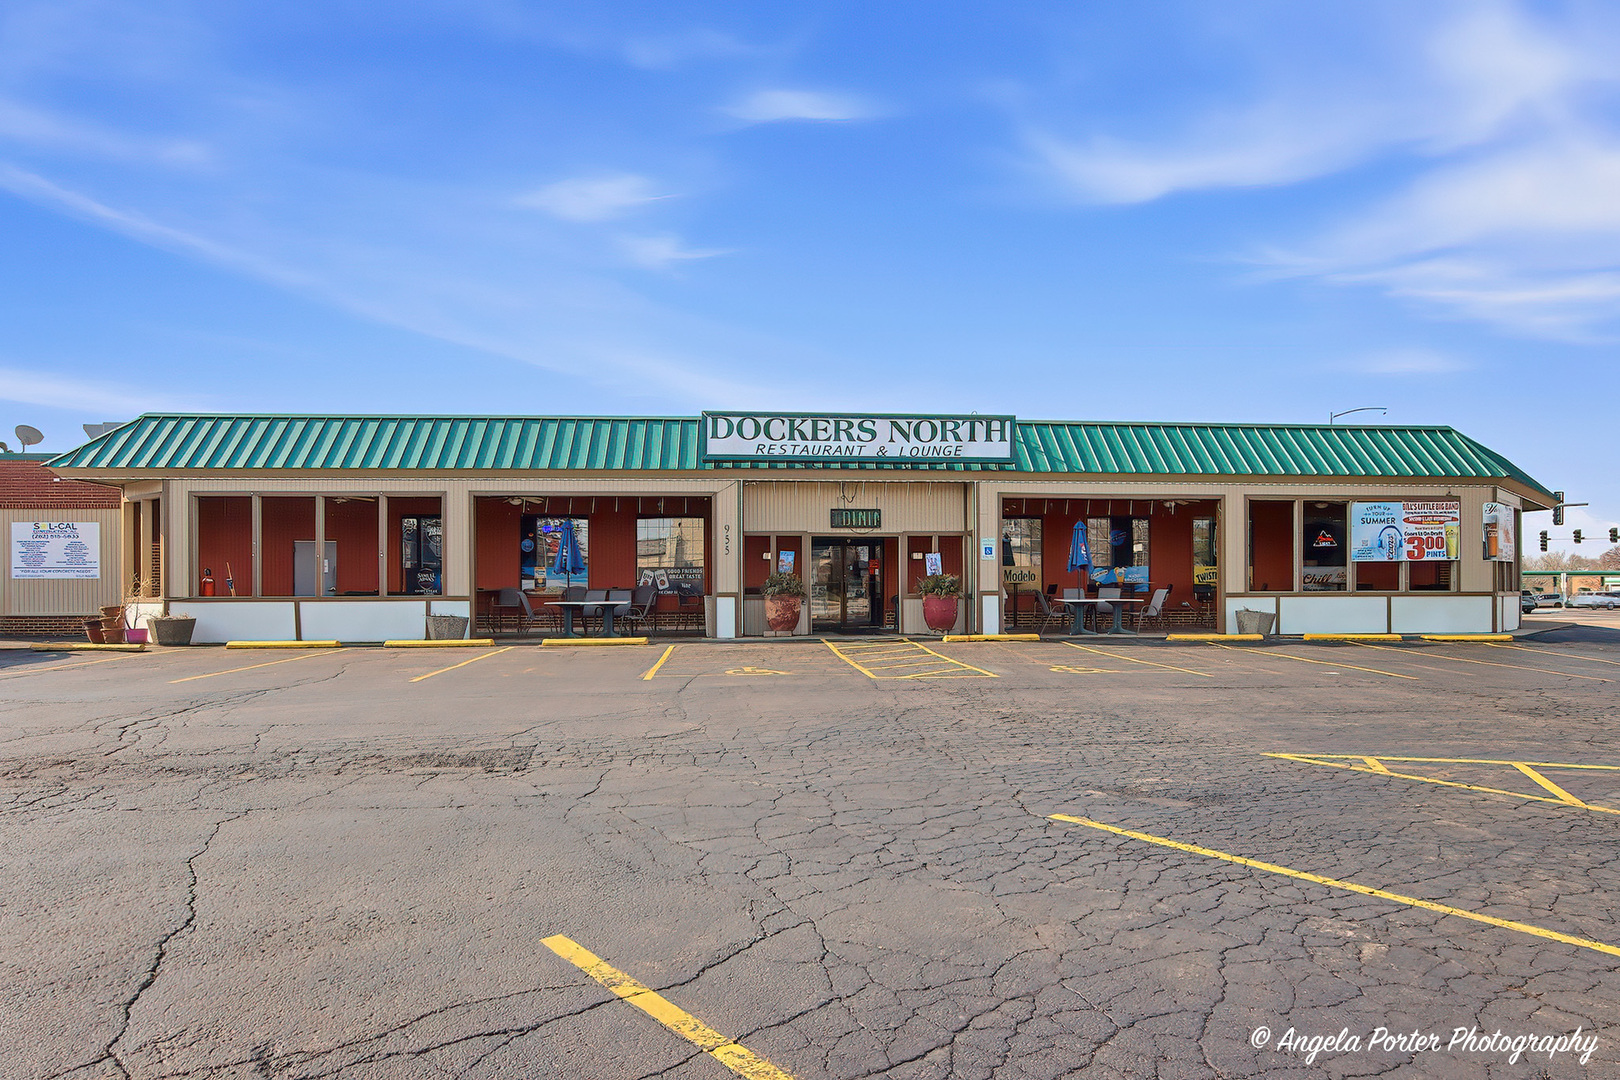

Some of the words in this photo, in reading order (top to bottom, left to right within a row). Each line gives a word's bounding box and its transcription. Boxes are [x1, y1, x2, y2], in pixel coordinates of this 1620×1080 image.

[710, 417, 877, 442] DOCKERS
[888, 419, 1007, 443] NORTH
[755, 443, 867, 456] RESTAURANT
[876, 445, 888, 457] &
[899, 445, 963, 457] LOUNGE
[1003, 569, 1035, 581] Modelo
[1303, 573, 1333, 584] Chill
